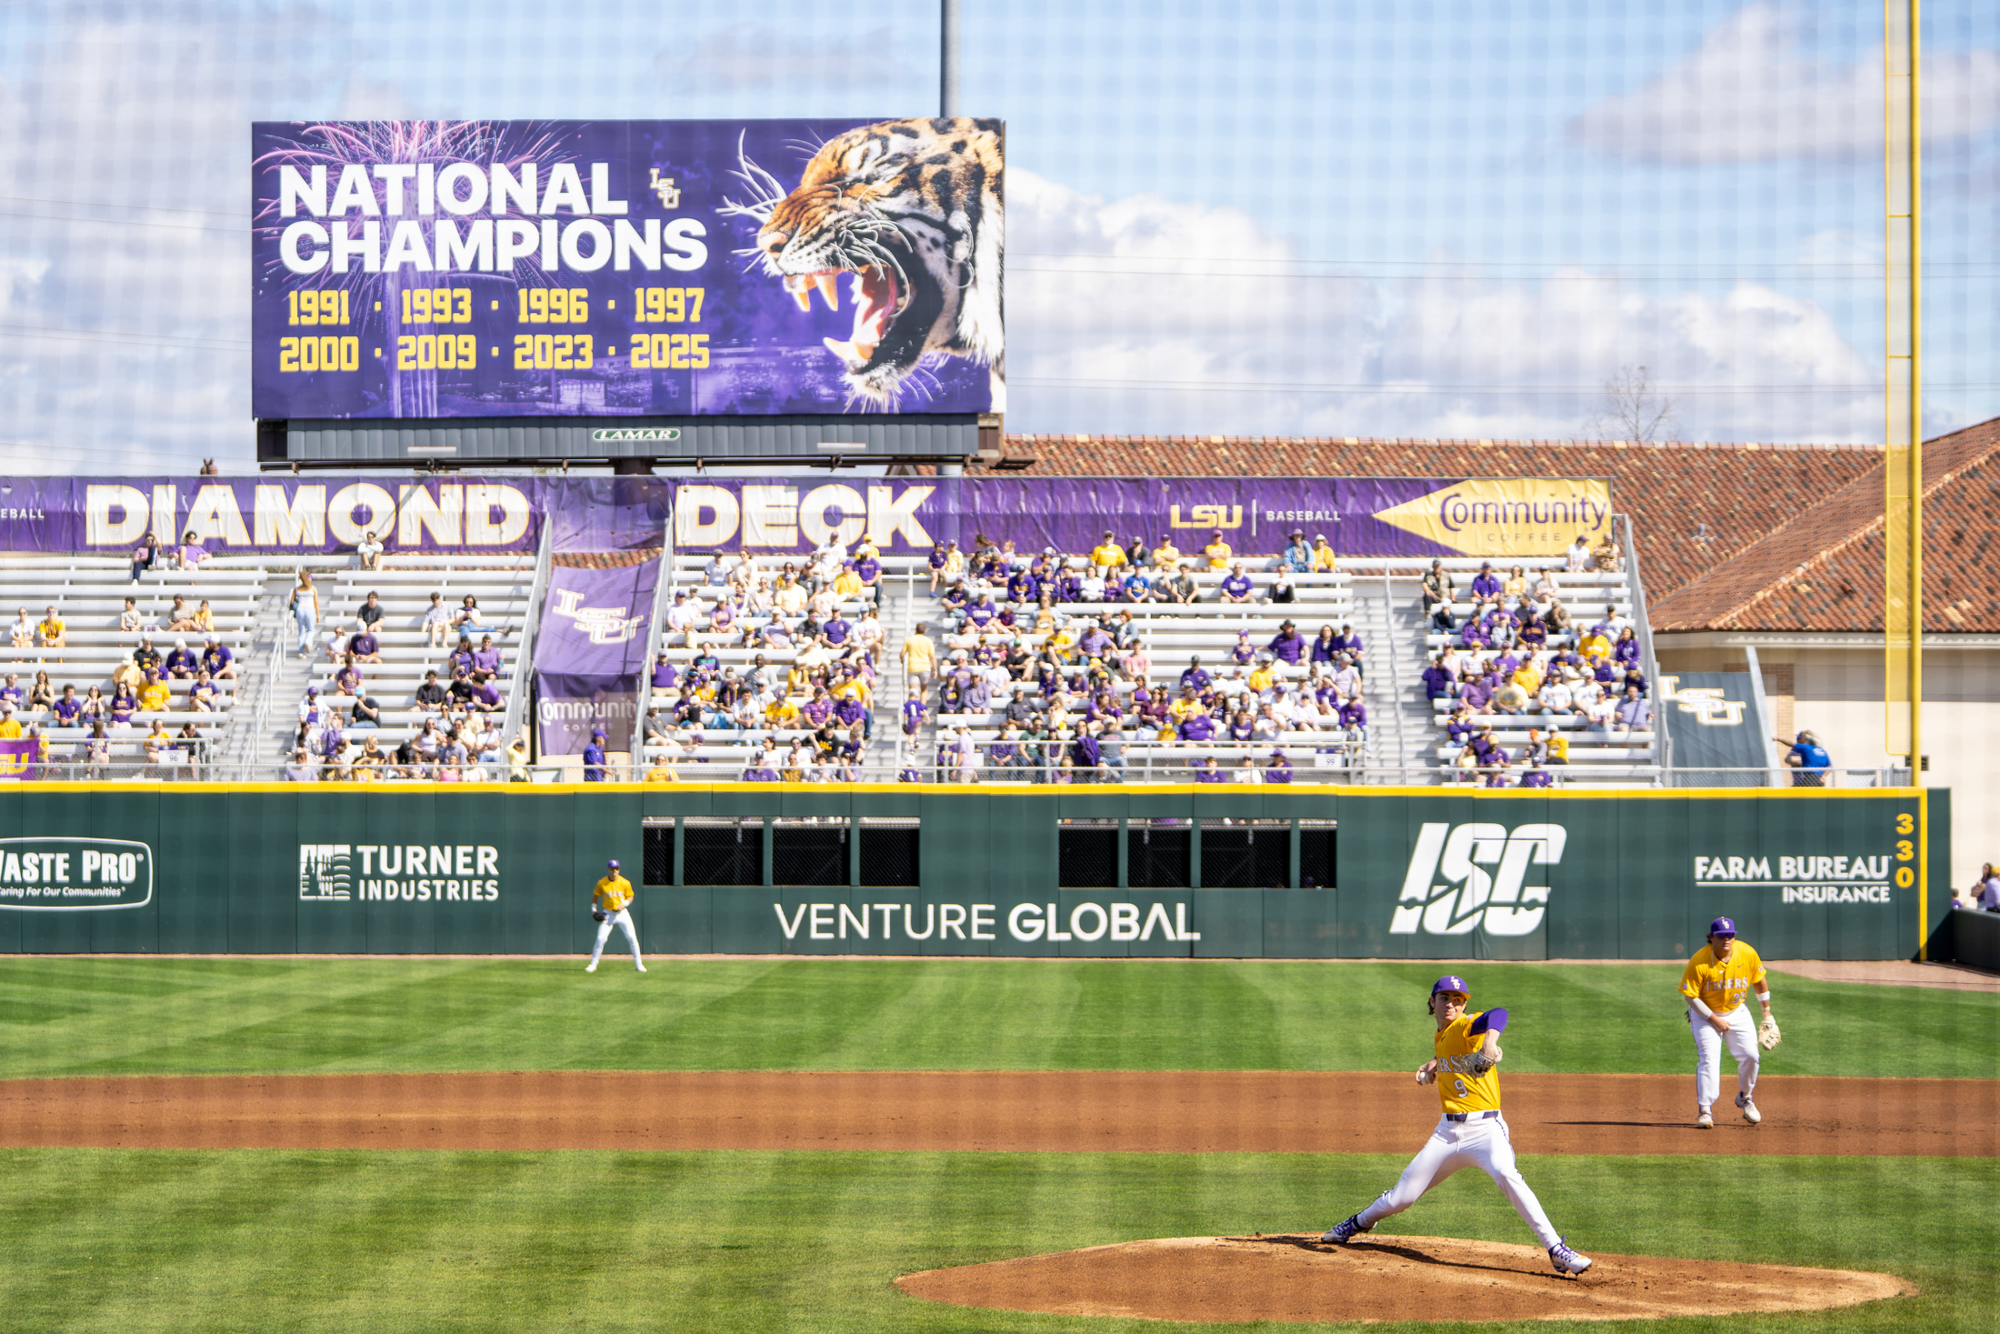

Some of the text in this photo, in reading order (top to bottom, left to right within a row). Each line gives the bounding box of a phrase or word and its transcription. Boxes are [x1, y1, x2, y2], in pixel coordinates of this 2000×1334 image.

[280, 163, 628, 216] NATIONAL
[650, 168, 681, 209] LSU
[279, 218, 708, 273] CHAMPIONS
[288, 287, 705, 325] 1991 1993 1996 1997
[280, 333, 709, 371] 2000 2009 2023 2025
[599, 430, 672, 440] LAMAR
[86, 483, 936, 547] DIAMOND DECK
[1170, 504, 1341, 529] LSU BASEBALL
[1440, 494, 1608, 532] Community
[1487, 533, 1562, 542] COFFEE
[552, 588, 644, 644] LSU
[1659, 675, 1747, 726] LSU
[169, 754, 178, 762] 96
[0, 850, 70, 883] ASTE
[356, 845, 499, 876] TURNER
[1694, 855, 1889, 880] FARM BUREAU
[0, 886, 122, 899] aring For Our Communities
[358, 880, 499, 901] INDUSTRIES
[1389, 822, 1567, 936] ISC
[1782, 886, 1890, 903] INSURANCE
[774, 902, 1201, 942] VENTURE GLOBAL
[1450, 976, 1460, 989] LSU
[1705, 976, 1749, 992] TIGERS
[1454, 1079, 1468, 1098] 9
